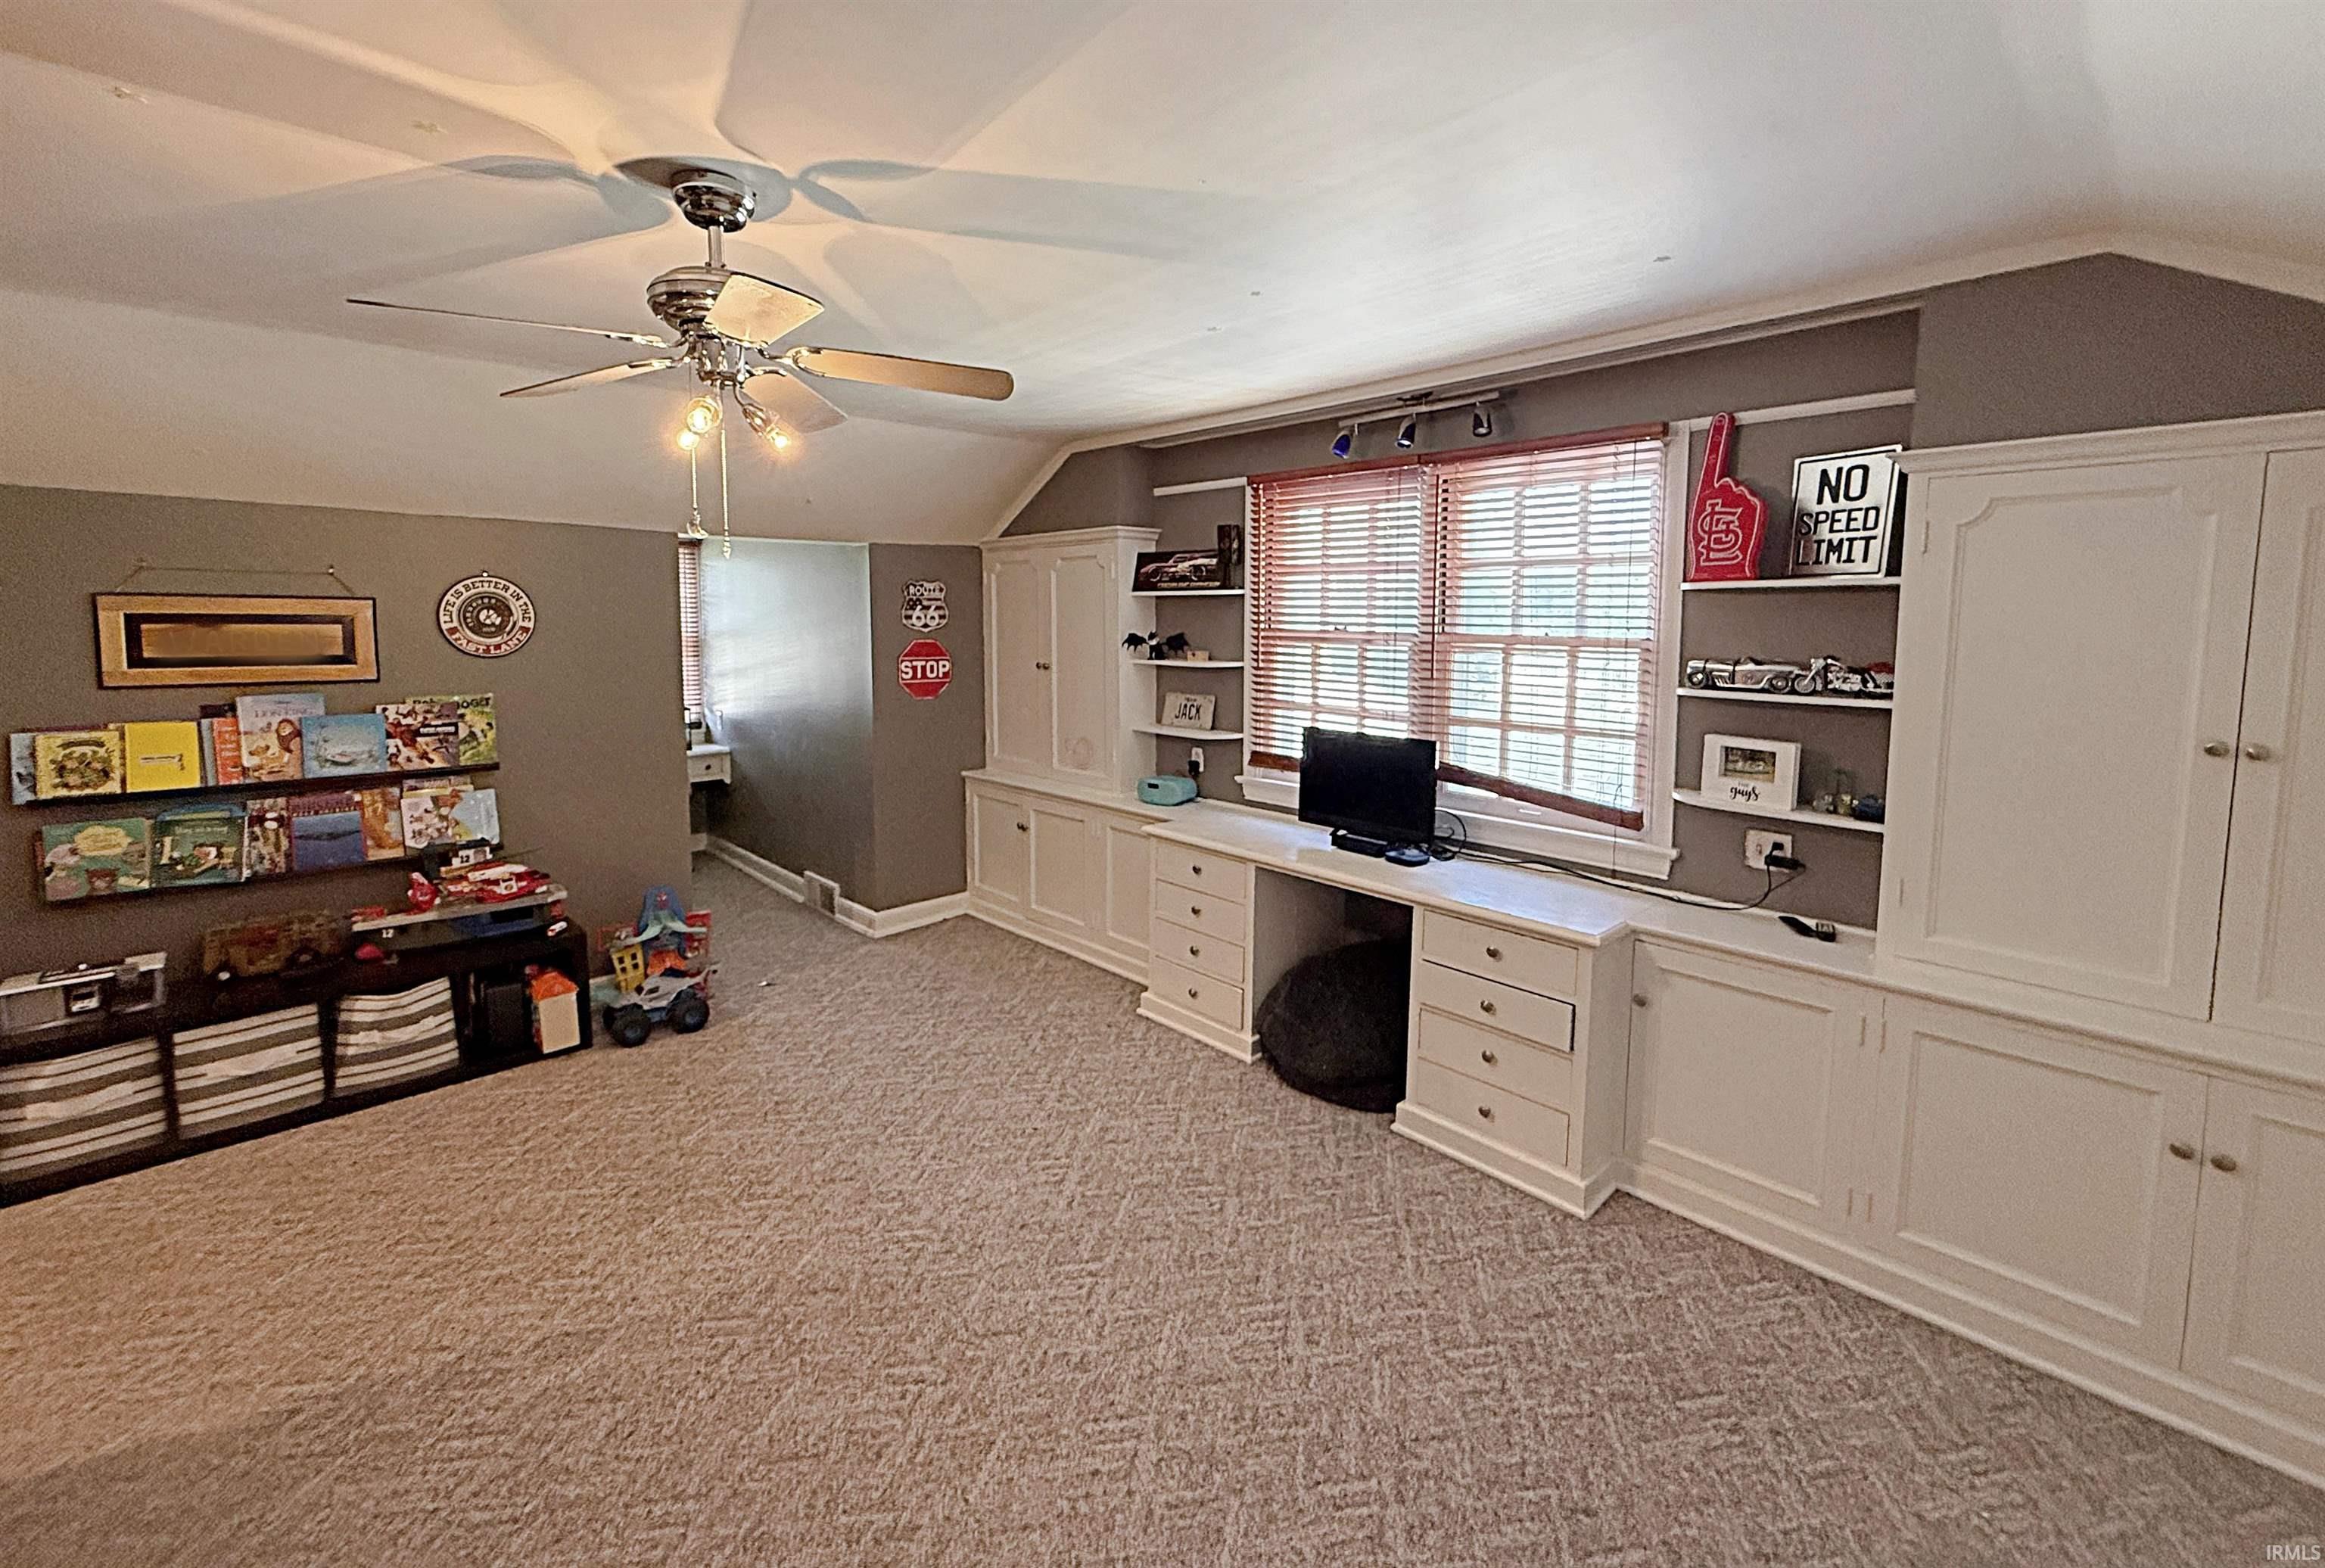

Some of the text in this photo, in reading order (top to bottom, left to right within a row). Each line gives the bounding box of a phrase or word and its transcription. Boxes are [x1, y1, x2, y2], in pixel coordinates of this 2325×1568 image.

[1816, 464, 1869, 505] NO
[1797, 506, 1880, 536] SPEED
[1795, 536, 1877, 565] LIMIT
[444, 580, 531, 624] LIFE IS BETTER IN THE
[912, 605, 939, 627] 66
[453, 630, 527, 653] FAST LANE
[901, 660, 950, 680] STOP
[1175, 703, 1202, 720] JACK
[1730, 786, 1761, 802] guys
